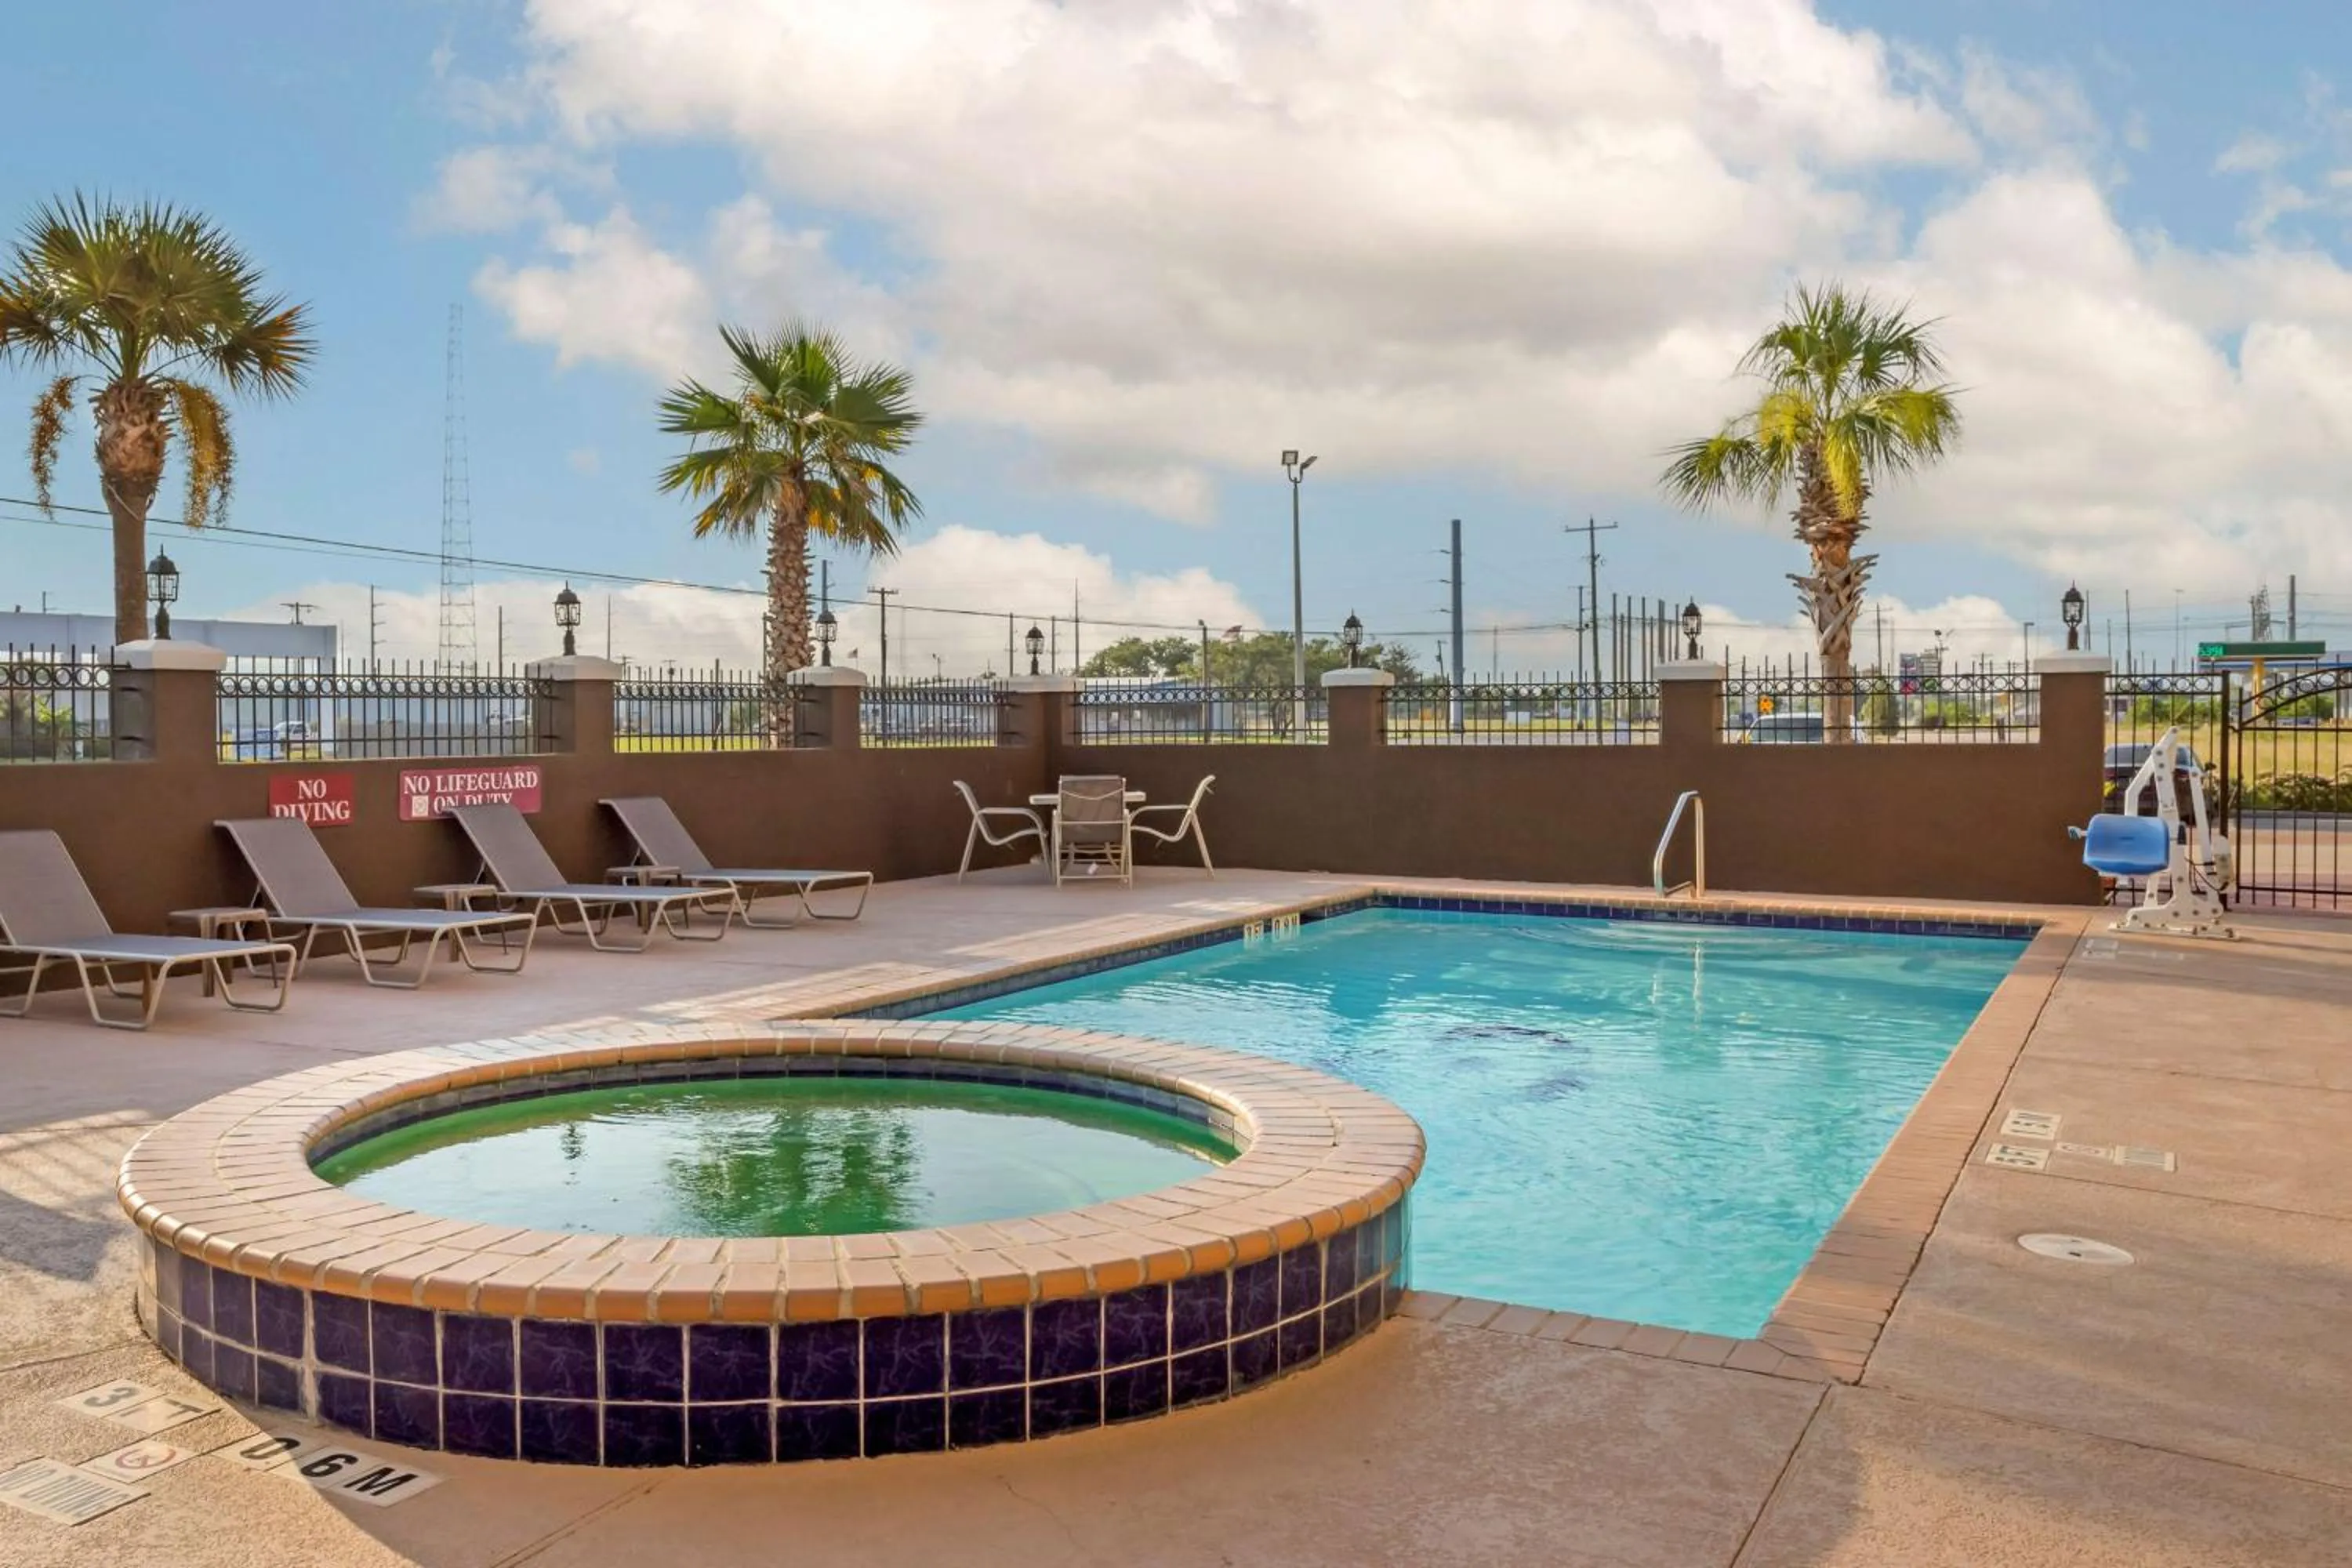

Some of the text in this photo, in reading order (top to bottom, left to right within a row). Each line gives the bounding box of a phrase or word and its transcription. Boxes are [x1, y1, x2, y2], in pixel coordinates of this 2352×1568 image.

[297, 779, 327, 800] NO
[404, 771, 539, 794] NO LIFEGUARD
[274, 800, 350, 822] DIVING
